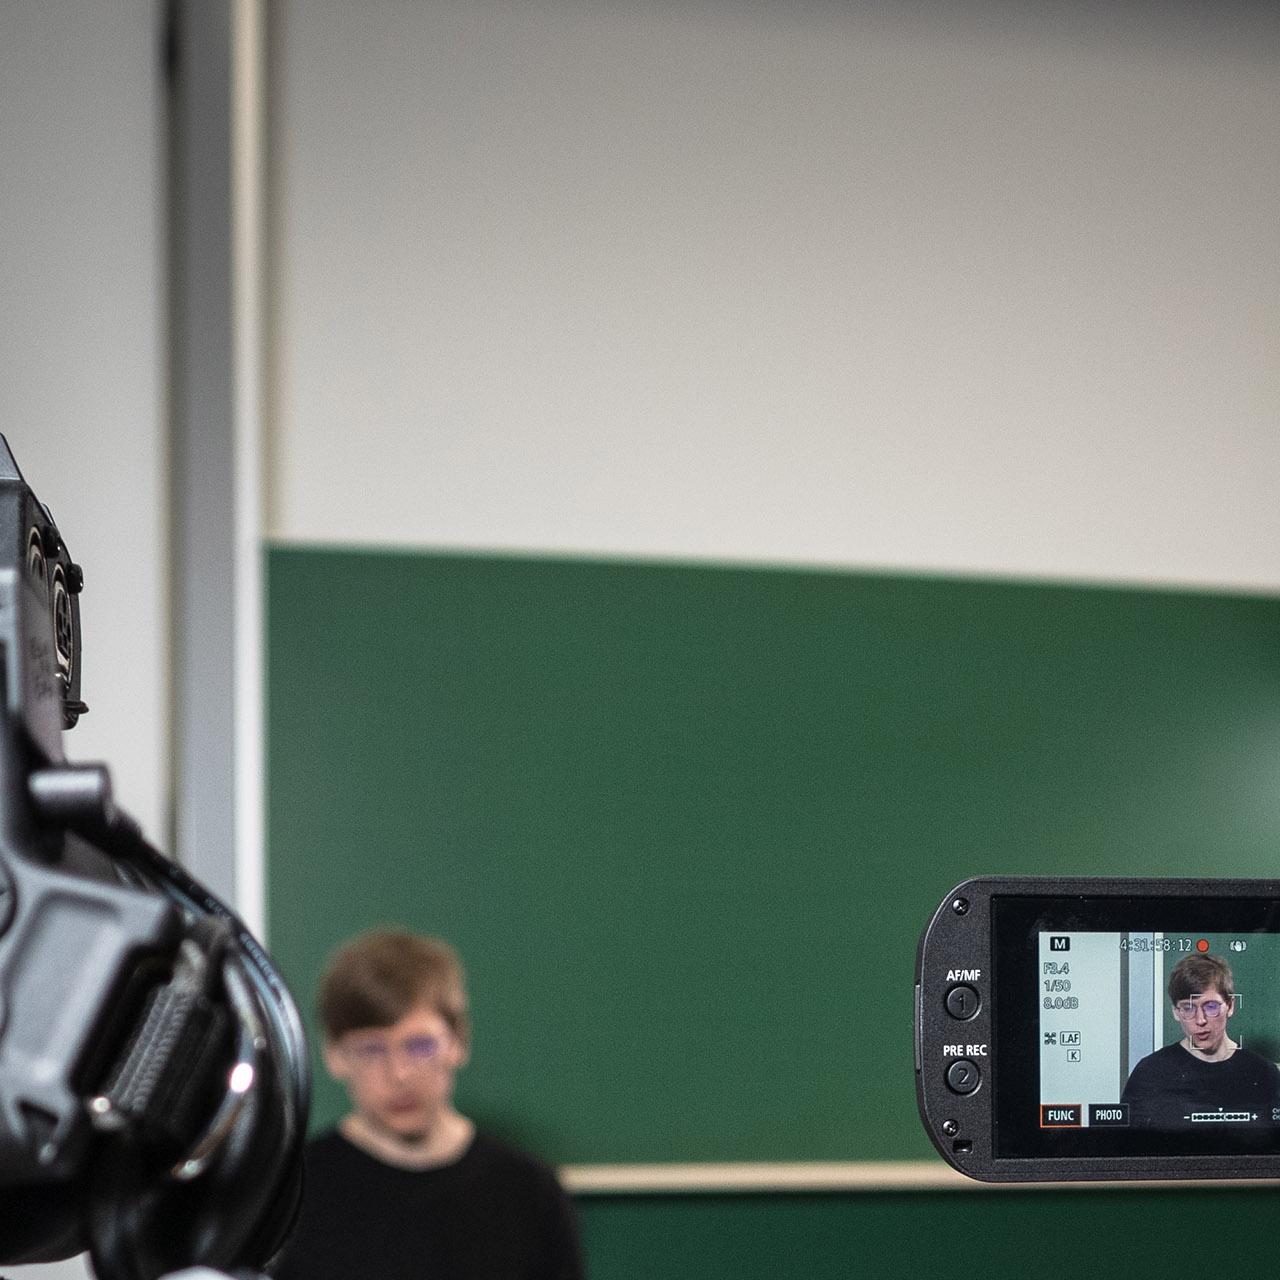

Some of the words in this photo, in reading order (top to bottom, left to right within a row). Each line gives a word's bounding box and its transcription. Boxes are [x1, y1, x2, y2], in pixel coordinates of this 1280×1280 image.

[1054, 939, 1066, 949] M
[1119, 938, 1192, 952] 4:31:58:12
[1043, 962, 1070, 974] F3.4
[946, 969, 981, 981] AF/MF
[1044, 979, 1071, 992] 1/50
[1043, 997, 1079, 1010] 8.0dB
[943, 1045, 964, 1056] PRE
[966, 1044, 987, 1056] REC
[1048, 1110, 1074, 1121] FUNC
[1095, 1109, 1123, 1120] PHOTO
